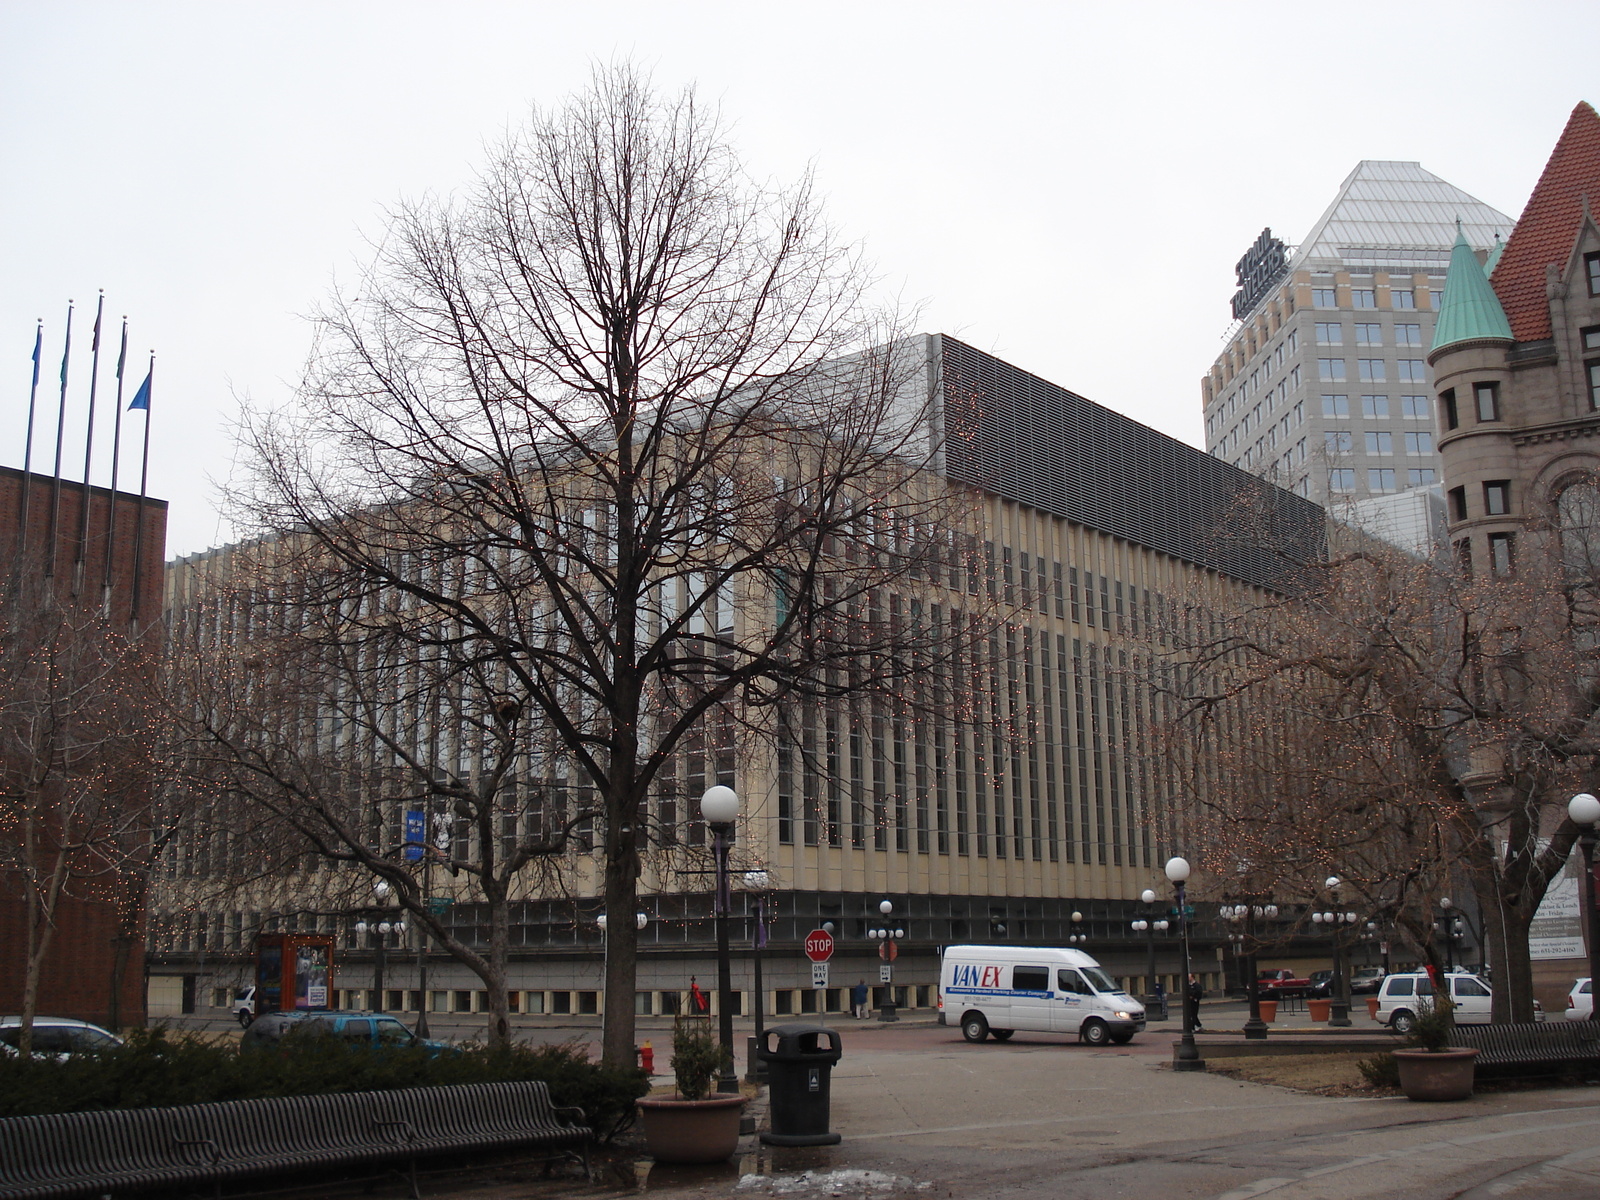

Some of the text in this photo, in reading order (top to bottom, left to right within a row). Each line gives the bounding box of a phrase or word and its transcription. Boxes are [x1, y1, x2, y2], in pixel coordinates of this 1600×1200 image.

[1246, 226, 1272, 272] PAUL
[1229, 240, 1286, 320] TRAVELERS
[807, 940, 832, 952] STOP
